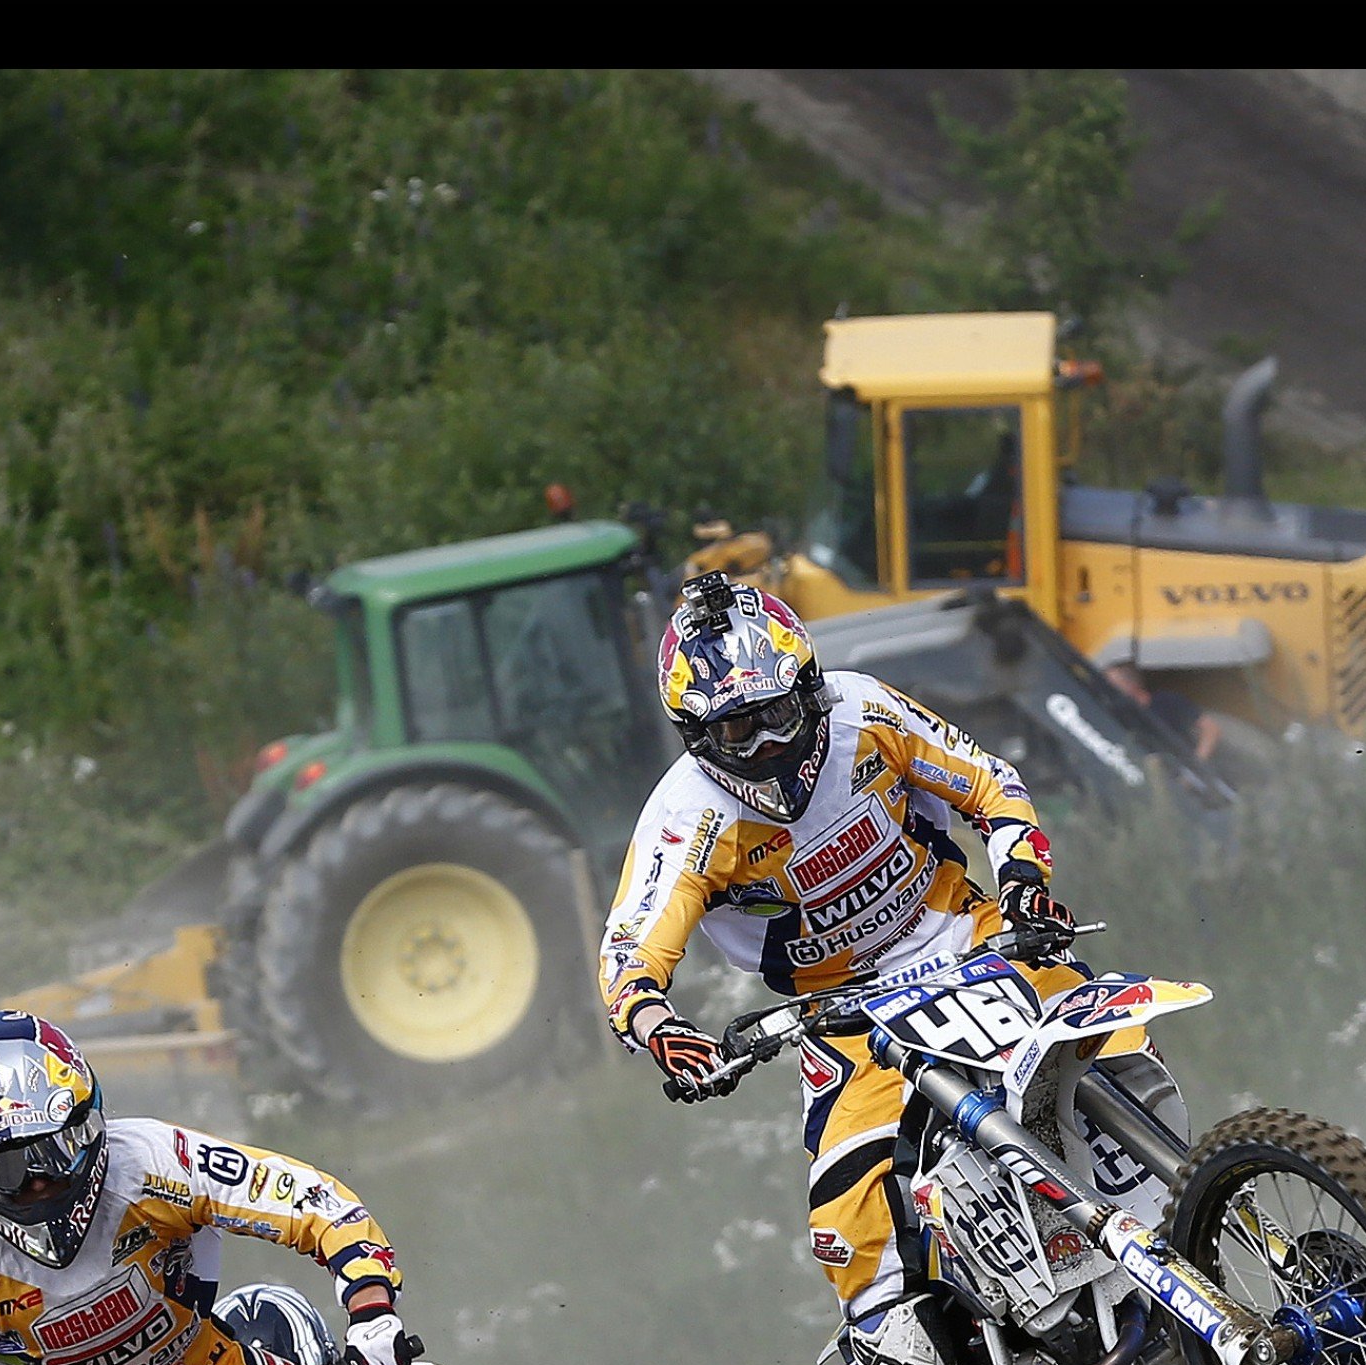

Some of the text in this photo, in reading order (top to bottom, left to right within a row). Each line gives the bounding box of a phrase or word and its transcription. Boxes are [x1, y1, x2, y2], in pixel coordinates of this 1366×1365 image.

[1160, 581, 1311, 606] VOLVO
[792, 815, 881, 892] nestaan
[811, 850, 910, 928] WILVO
[827, 853, 937, 956] Husqvarna
[37, 1285, 140, 1351] nestaan
[1123, 1247, 1223, 1337] BEL RAY
